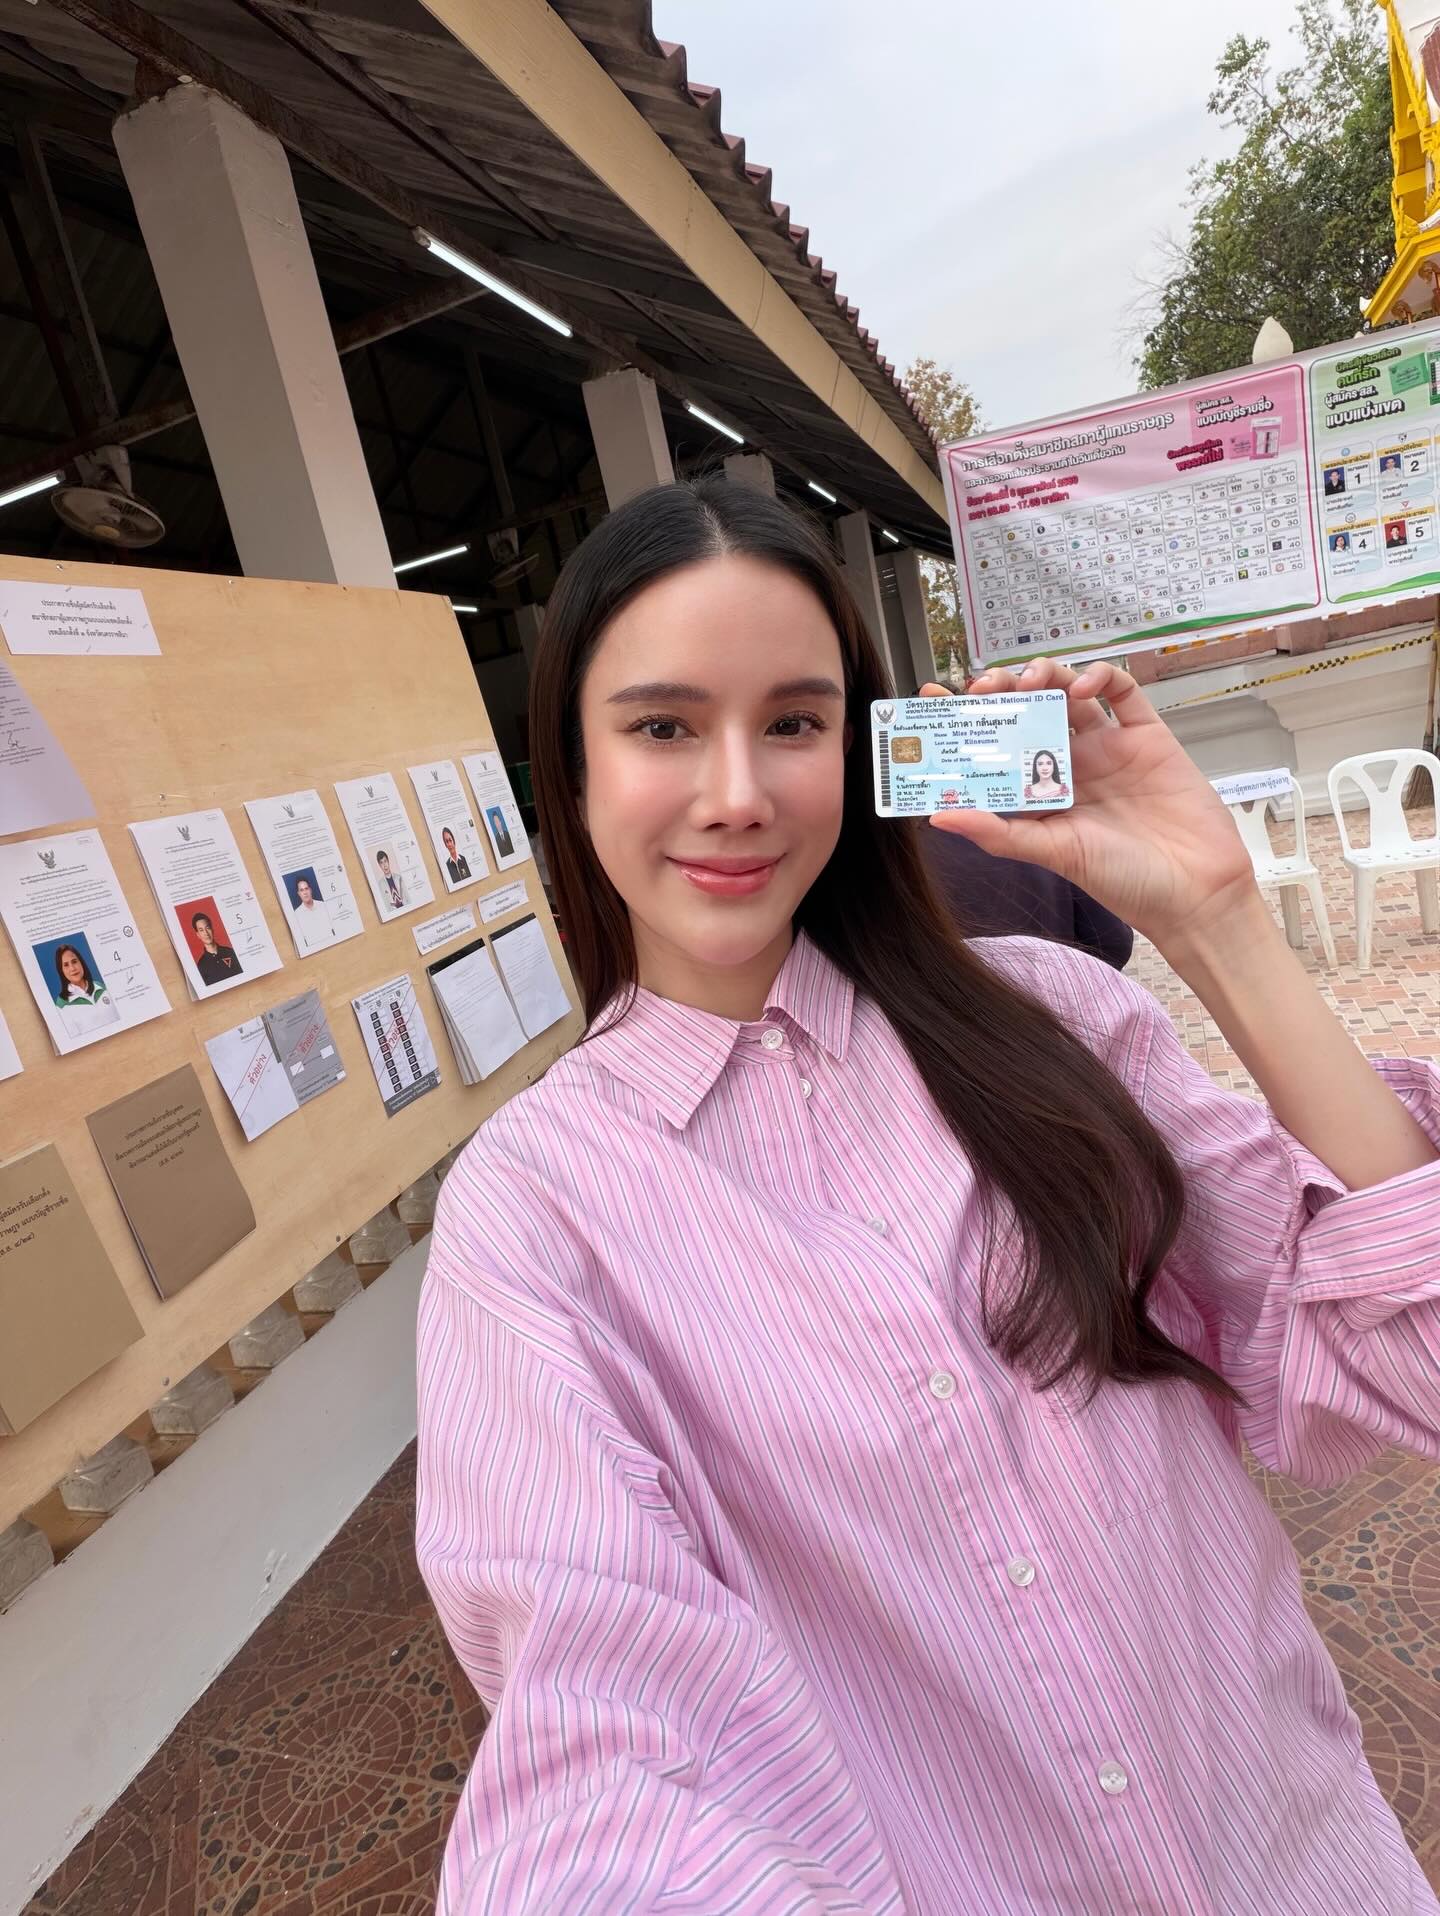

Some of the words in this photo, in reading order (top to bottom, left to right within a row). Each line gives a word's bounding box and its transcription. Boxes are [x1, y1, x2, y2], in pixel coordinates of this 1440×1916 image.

[1337, 365, 1380, 388] คนที่รัก
[1325, 390, 1360, 409] ผู้สมัคร
[1359, 385, 1378, 397] สส.
[1196, 395, 1274, 427] แบบบัญชีรายชื่อ
[1326, 399, 1405, 428] แบบแบ่งเขต
[962, 412, 1174, 471] การเลือกตั้งสมาชิกสภาผู้แทนราษฎร
[1410, 460, 1419, 471] 2
[1354, 474, 1361, 484] 1
[1415, 527, 1424, 538] 5
[1359, 539, 1367, 549] 4
[906, 698, 980, 709] บัตรประจำตัวประชาชน
[929, 720, 944, 730] น.ส.
[330, 882, 336, 892] 6
[236, 913, 244, 926] 5
[113, 950, 122, 963] 4
[300, 1023, 320, 1056] ตัวอย่าง
[247, 1053, 267, 1086] ตัวอย่าง
